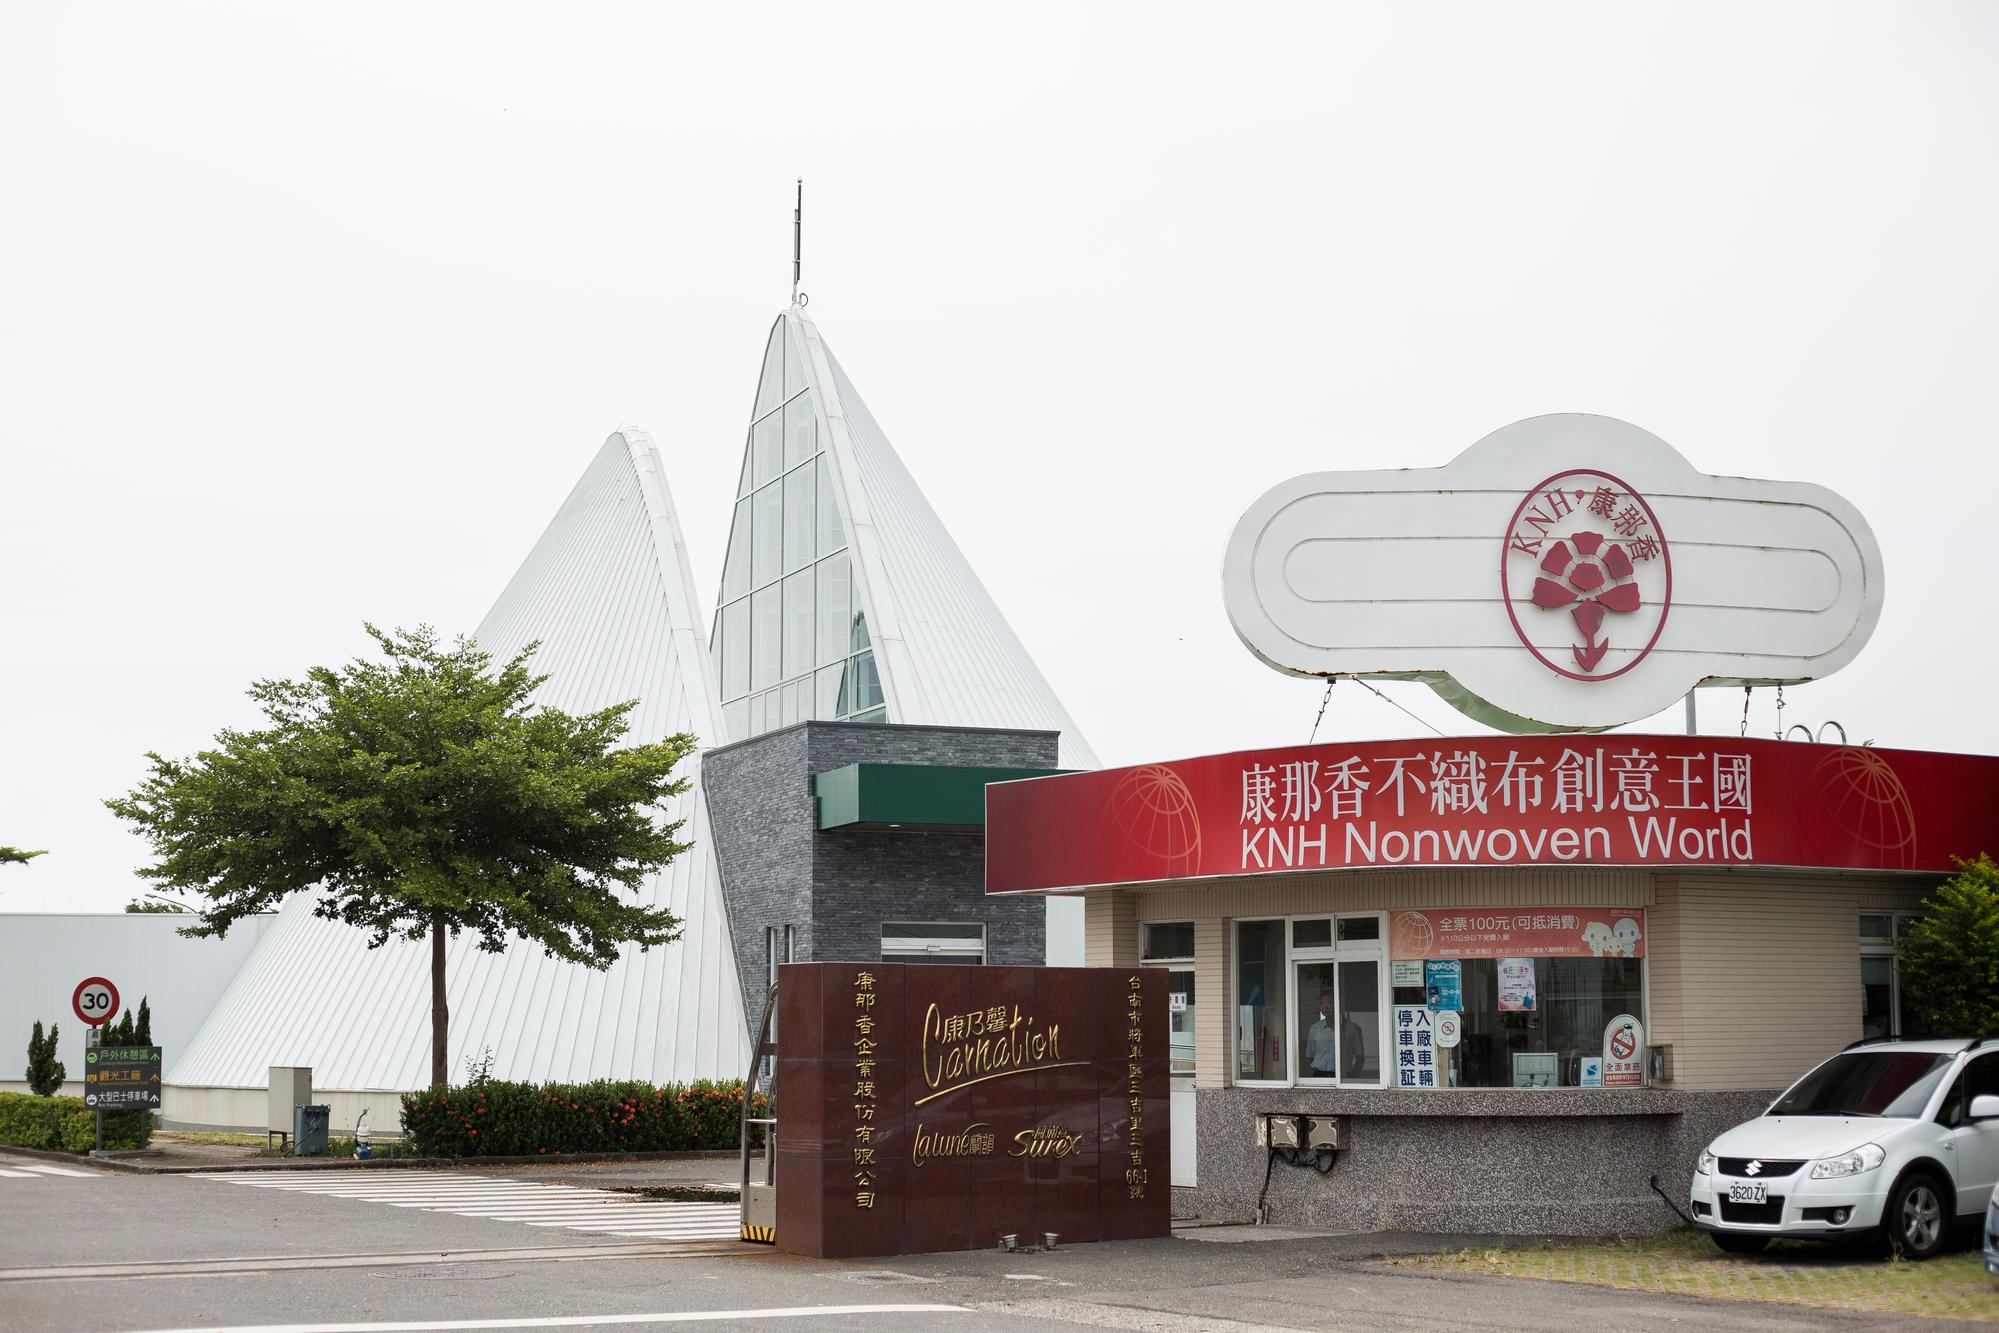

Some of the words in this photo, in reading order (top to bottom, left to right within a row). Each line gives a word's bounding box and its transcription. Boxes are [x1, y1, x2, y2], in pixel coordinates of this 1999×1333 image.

[1587, 485, 1660, 563] 康那香
[1239, 748, 1753, 826] 康那香不織布創意王國
[1241, 823, 1328, 869] KNH
[1344, 820, 1611, 864] Nonwoven
[1627, 816, 1753, 861] World
[82, 992, 109, 1010] 30
[922, 1003, 1061, 1089] Carnation
[942, 1005, 1007, 1045] 康乃馨
[100, 1049, 149, 1060] 戶外休憩區
[1398, 1010, 1416, 1087] 停車換証
[1416, 1010, 1433, 1087] 入廠車輛
[98, 1090, 149, 1102] 大型巴士停車場
[100, 1070, 141, 1081] 觀光工廠
[853, 971, 876, 1210] 康那香企業股份有限公司
[970, 1133, 995, 1155] 蘭韻
[1008, 1129, 1083, 1159] Surex
